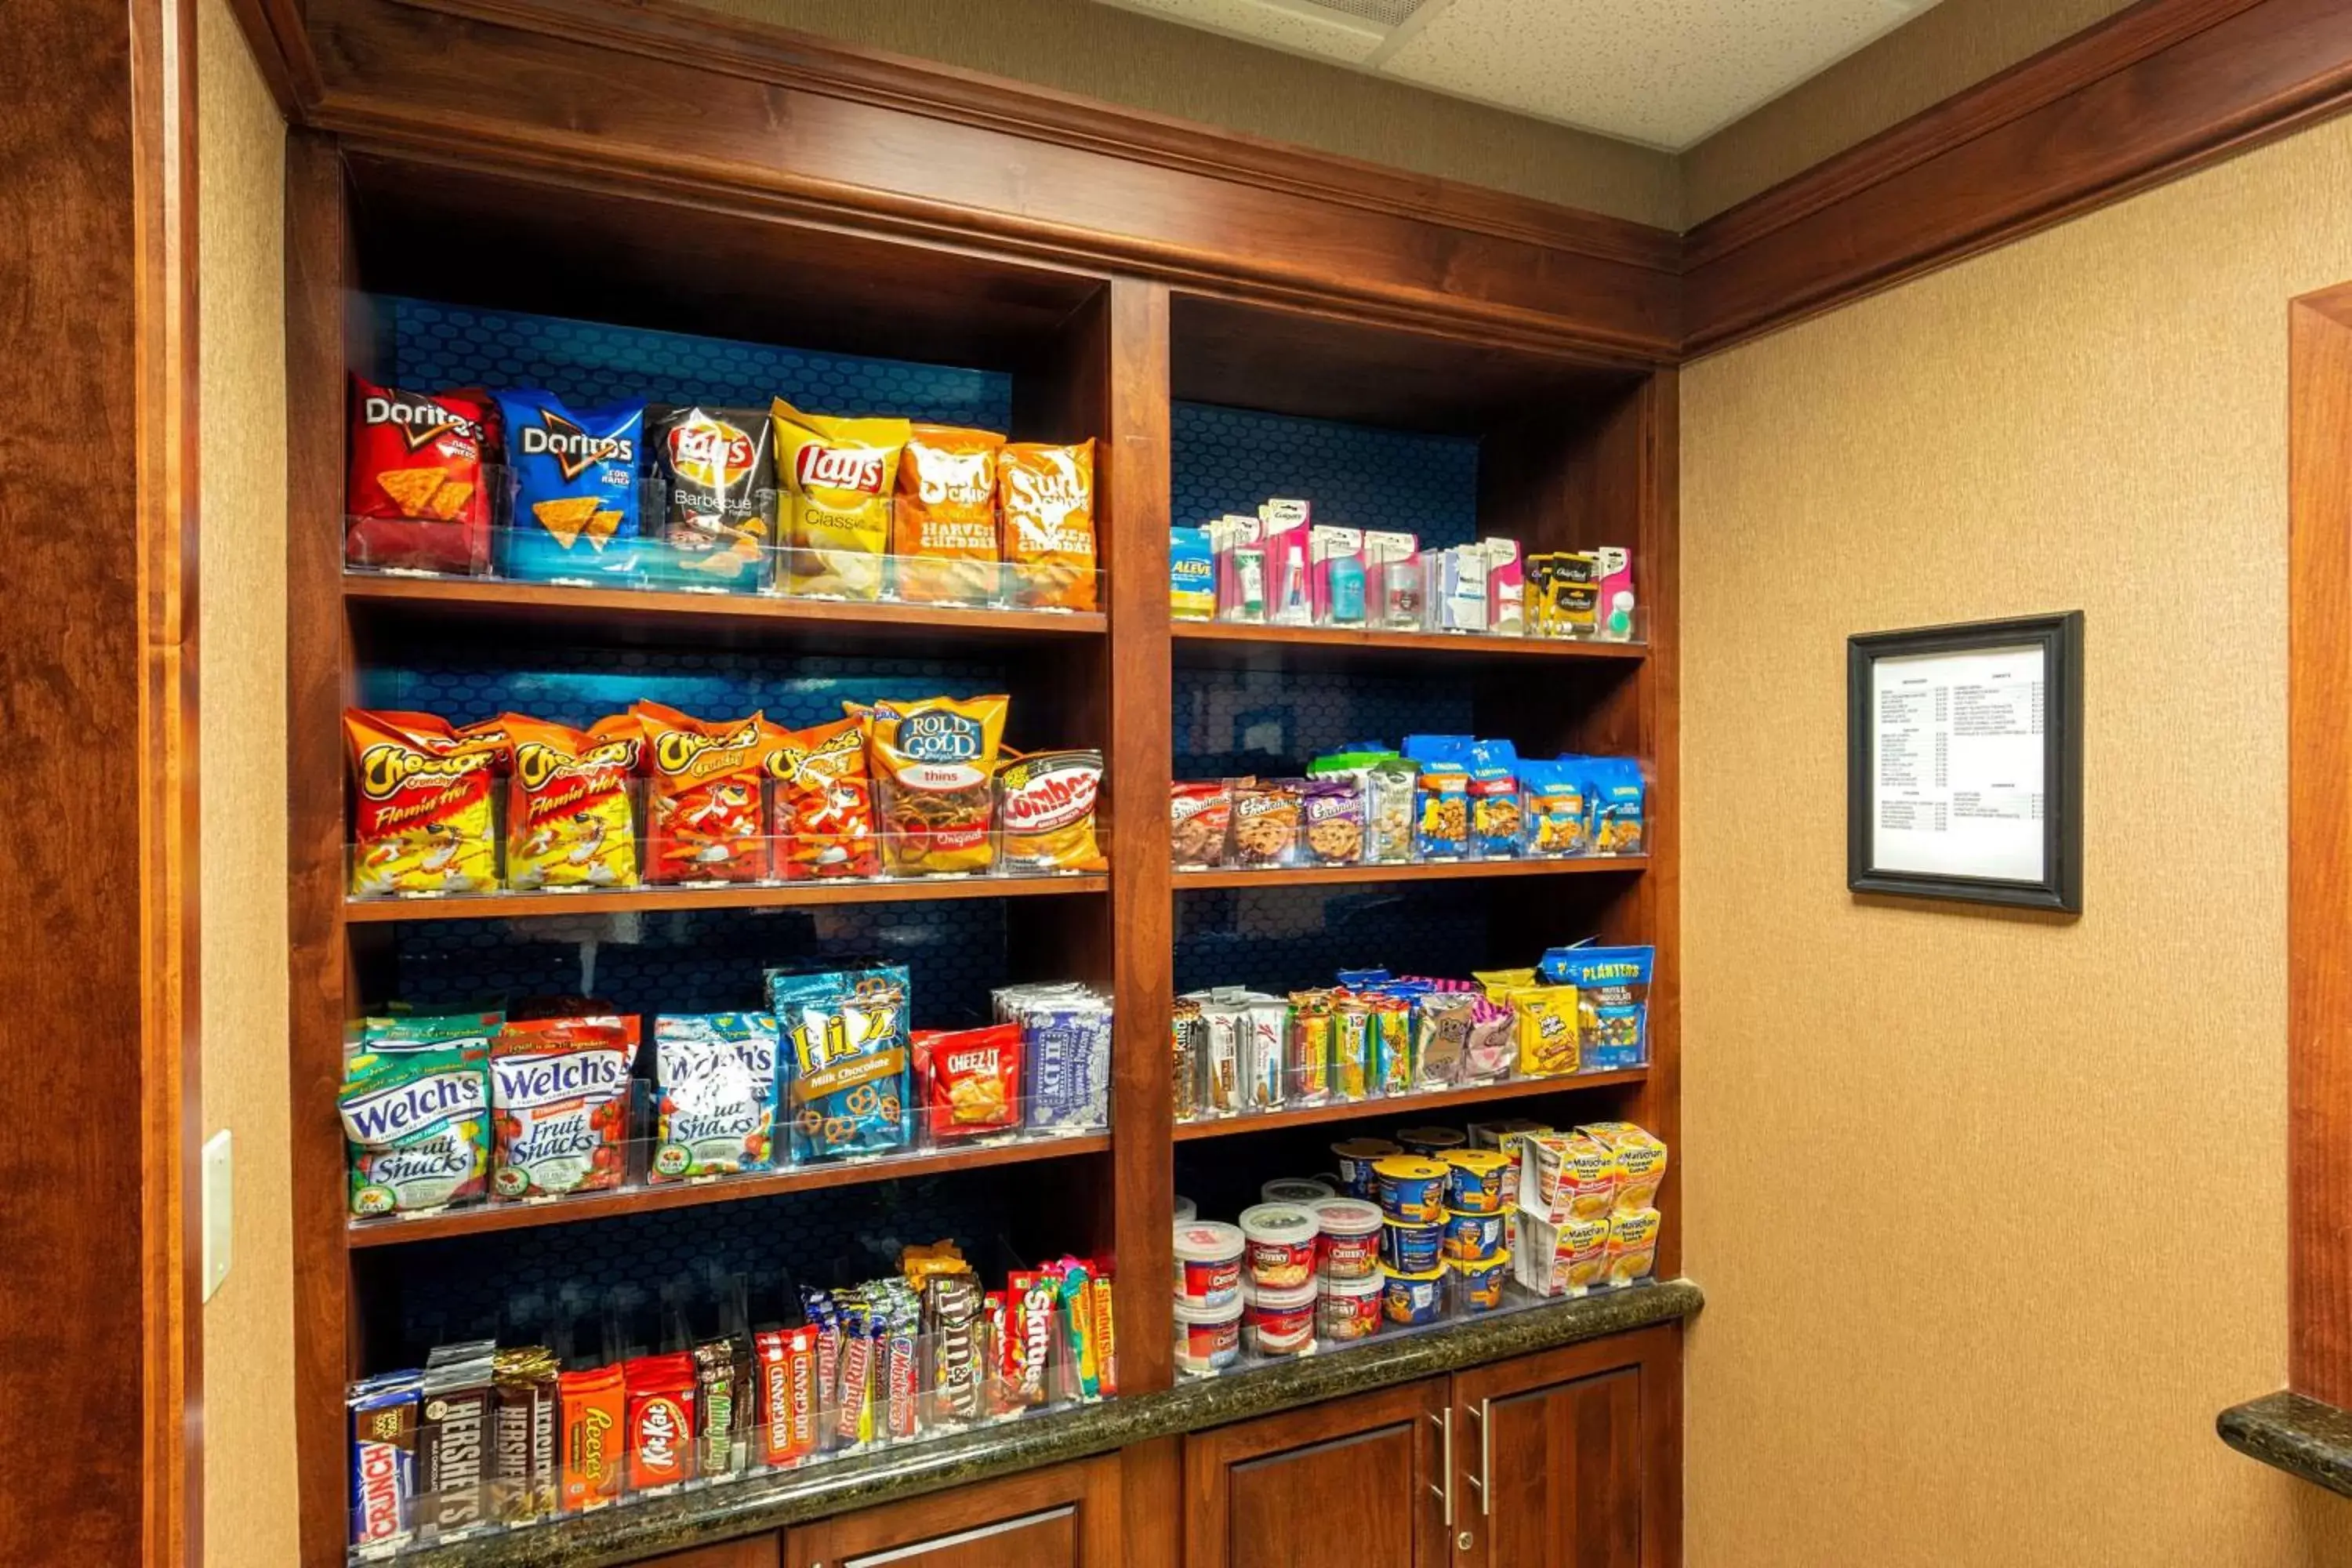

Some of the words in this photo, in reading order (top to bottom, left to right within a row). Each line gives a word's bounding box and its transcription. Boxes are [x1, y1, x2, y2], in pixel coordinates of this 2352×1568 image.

[365, 397, 484, 439] Doritos
[524, 427, 633, 461] Doritos
[675, 489, 752, 510] Barbecue
[1172, 561, 1211, 575] ALEVE
[911, 714, 971, 735] ROLD
[904, 734, 977, 759] GOLD
[924, 770, 958, 782] thins
[937, 828, 982, 848] Original
[1582, 962, 1640, 982] PLANTERS
[1177, 1021, 1188, 1051] KIND
[498, 1054, 616, 1100] Welch's
[837, 1058, 891, 1080] Chocolate
[1044, 1063, 1061, 1095] ACT
[348, 1077, 479, 1138] Welch's
[531, 1114, 586, 1144] Fruit
[399, 1134, 457, 1156] uit
[513, 1132, 595, 1166] Snacks
[1624, 1149, 1663, 1160] Maruchan
[376, 1153, 468, 1184] Snacks
[770, 1367, 787, 1423] GRAND
[794, 1357, 808, 1413] GRAND
[439, 1400, 482, 1525] HERSHEY'S
[498, 1406, 528, 1504] HERSHEY'S
[363, 1443, 398, 1540] CRUNCH
